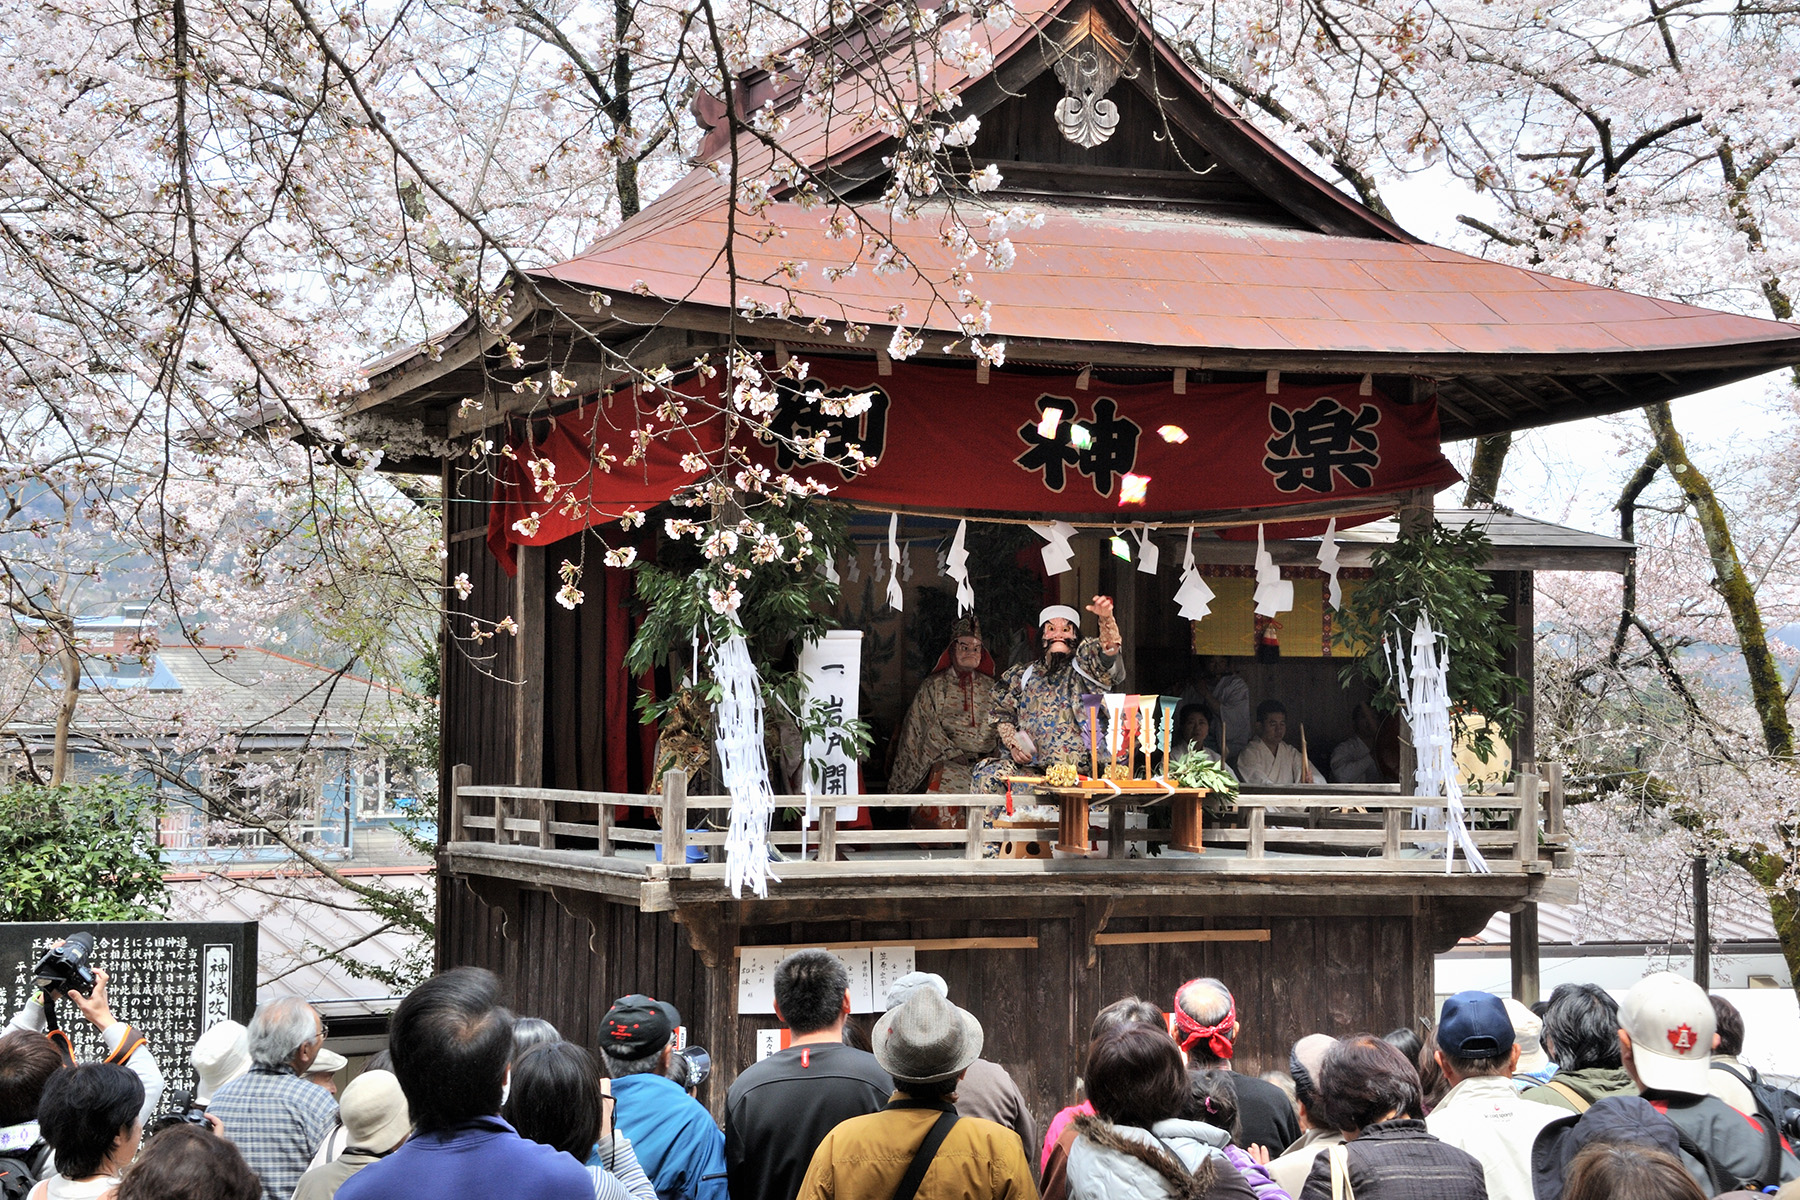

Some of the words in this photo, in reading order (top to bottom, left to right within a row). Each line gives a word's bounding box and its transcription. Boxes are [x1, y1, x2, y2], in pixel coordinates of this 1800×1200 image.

[14, 961, 27, 1016] 平成元年
[184, 948, 199, 1101] 当平成元年は大正四年当神
[1675, 1029, 1691, 1048] A
